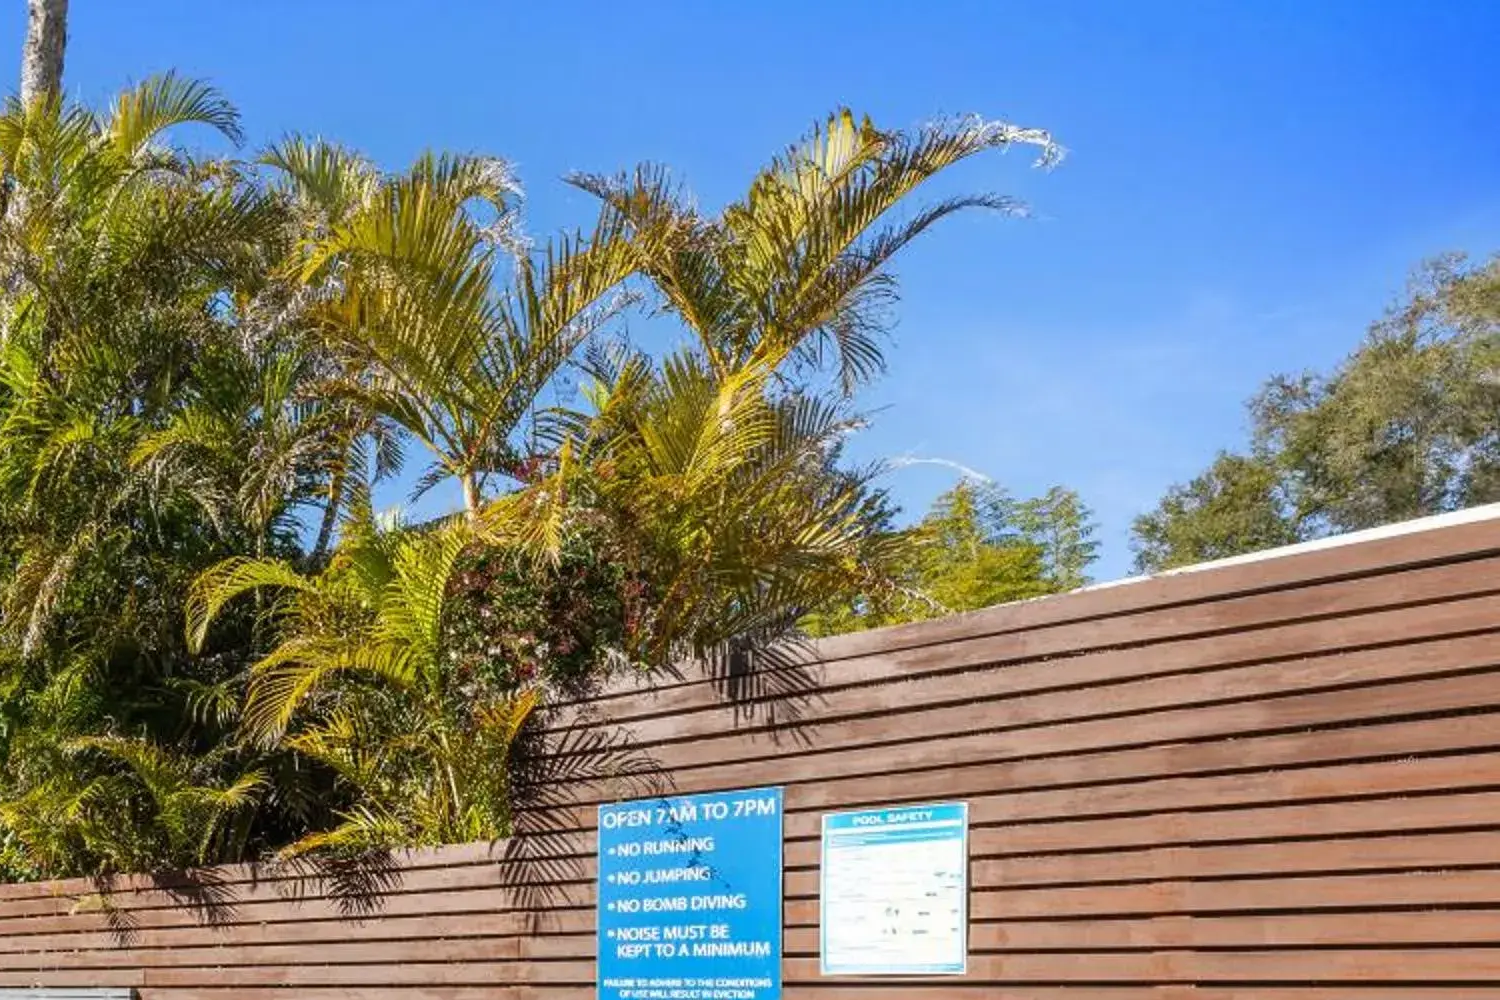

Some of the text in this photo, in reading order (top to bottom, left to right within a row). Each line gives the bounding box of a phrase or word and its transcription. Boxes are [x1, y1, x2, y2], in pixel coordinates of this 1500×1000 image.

[603, 797, 776, 829] OPEN 7AM TO 7PM
[852, 810, 933, 826] POOL SAFETY
[617, 837, 715, 857] NO RUNNING
[617, 866, 711, 885] NO JUMPING
[617, 893, 747, 913] NO BOMB DIVING
[617, 923, 730, 941] NOISE MUST BE
[617, 941, 771, 959] KEPT TO A MINIMUM
[603, 978, 635, 988] FAILURE
[715, 977, 772, 988] CONDITIONS
